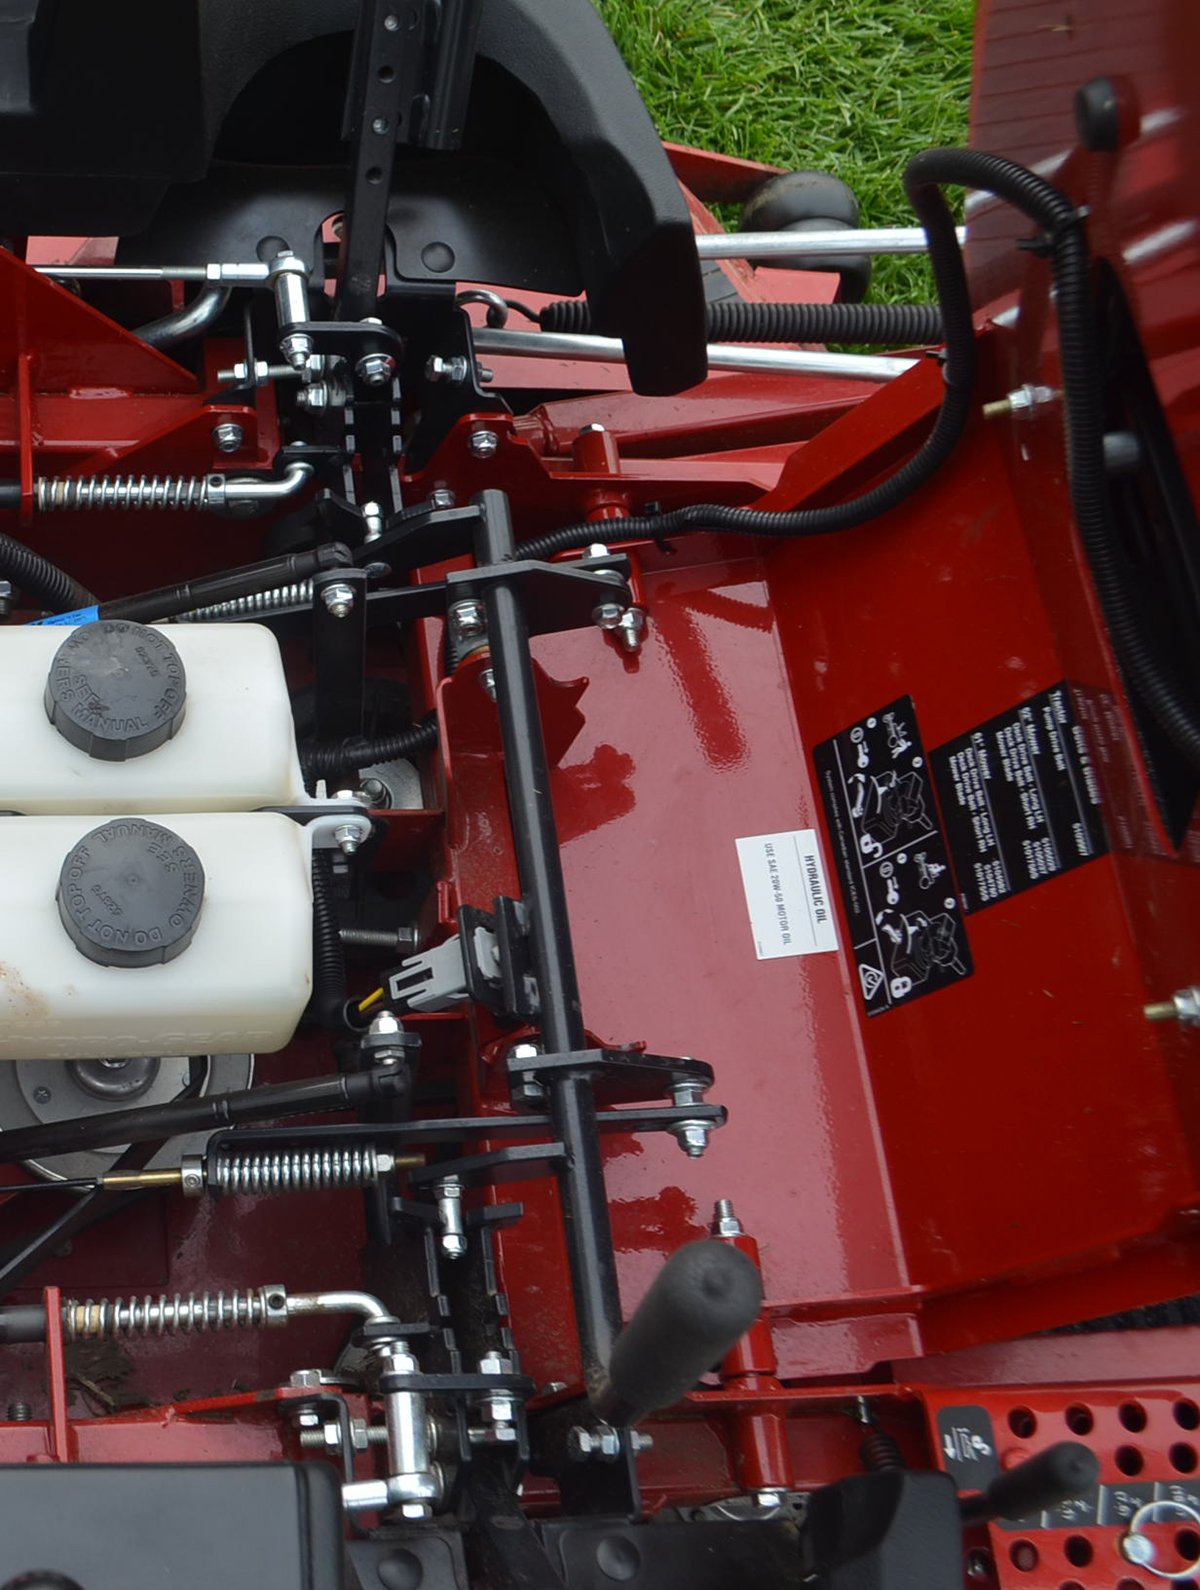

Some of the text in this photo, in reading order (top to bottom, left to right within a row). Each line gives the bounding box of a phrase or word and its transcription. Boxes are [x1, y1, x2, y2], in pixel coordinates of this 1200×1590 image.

[73, 702, 148, 731] MANUAL
[1002, 726, 1015, 747] Deck
[1012, 722, 1023, 743] Deck
[1024, 723, 1040, 754] Mower
[1042, 706, 1054, 730] Pump
[1048, 730, 1060, 753] Drive
[1054, 753, 1066, 770] Belt
[956, 751, 967, 772] Deck
[964, 747, 975, 768] Deck
[976, 749, 991, 779] Mower
[995, 730, 1014, 782] Mower Blade
[1008, 747, 1020, 769] Drive
[1016, 743, 1028, 765] Drive
[948, 755, 966, 805] Mower Blade
[961, 772, 972, 794] Drive
[969, 768, 980, 789] Drive
[1014, 769, 1025, 787] Belt
[1023, 765, 1034, 782] Belt
[966, 794, 977, 810] Belt
[975, 789, 985, 806] Belt
[1020, 792, 1033, 815] Short
[1026, 787, 1040, 810] Long
[92, 823, 173, 843] MANUAL
[972, 815, 984, 839] Short
[978, 811, 991, 834] Long
[764, 842, 792, 945] USE SAE 20W-50 MOTOR OIL
[804, 854, 827, 923] HYDRAULIC OIL
[88, 919, 130, 942] NOT
[135, 927, 163, 945] DO
